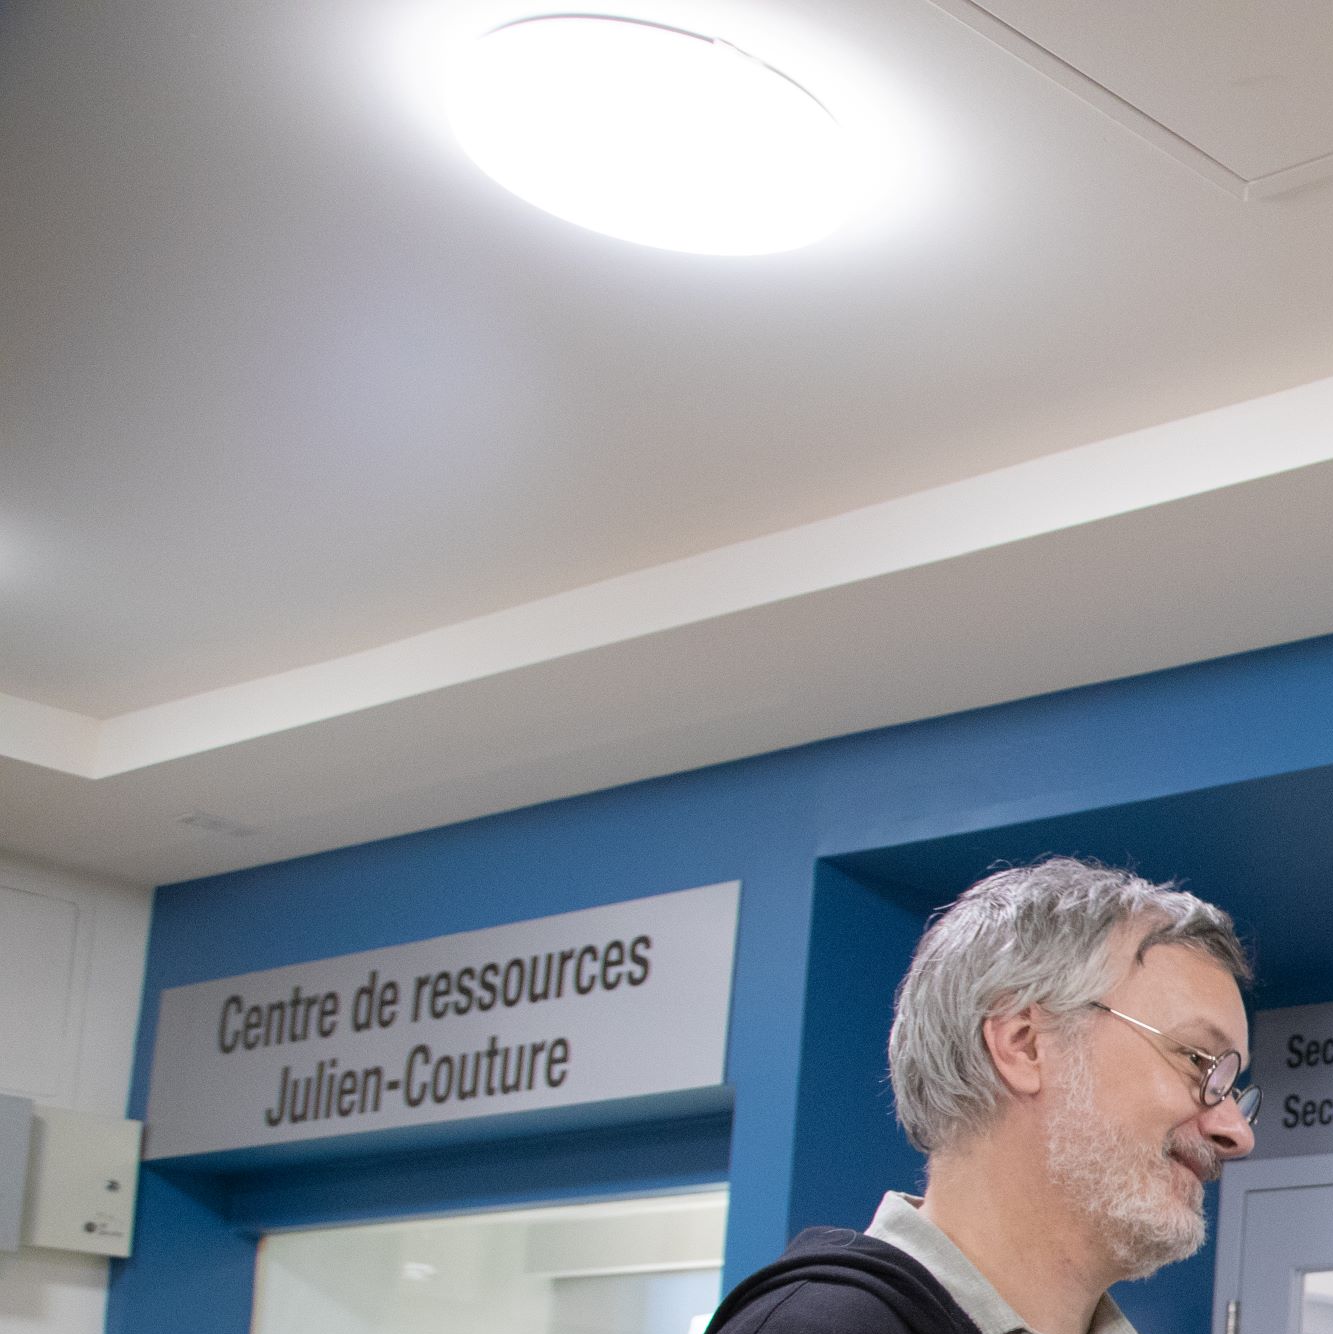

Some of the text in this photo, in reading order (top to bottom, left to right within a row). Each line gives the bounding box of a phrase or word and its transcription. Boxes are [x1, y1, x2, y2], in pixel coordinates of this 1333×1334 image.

[218, 934, 652, 1054] Centre de ressources
[265, 1036, 571, 1127] Julien-Couture
